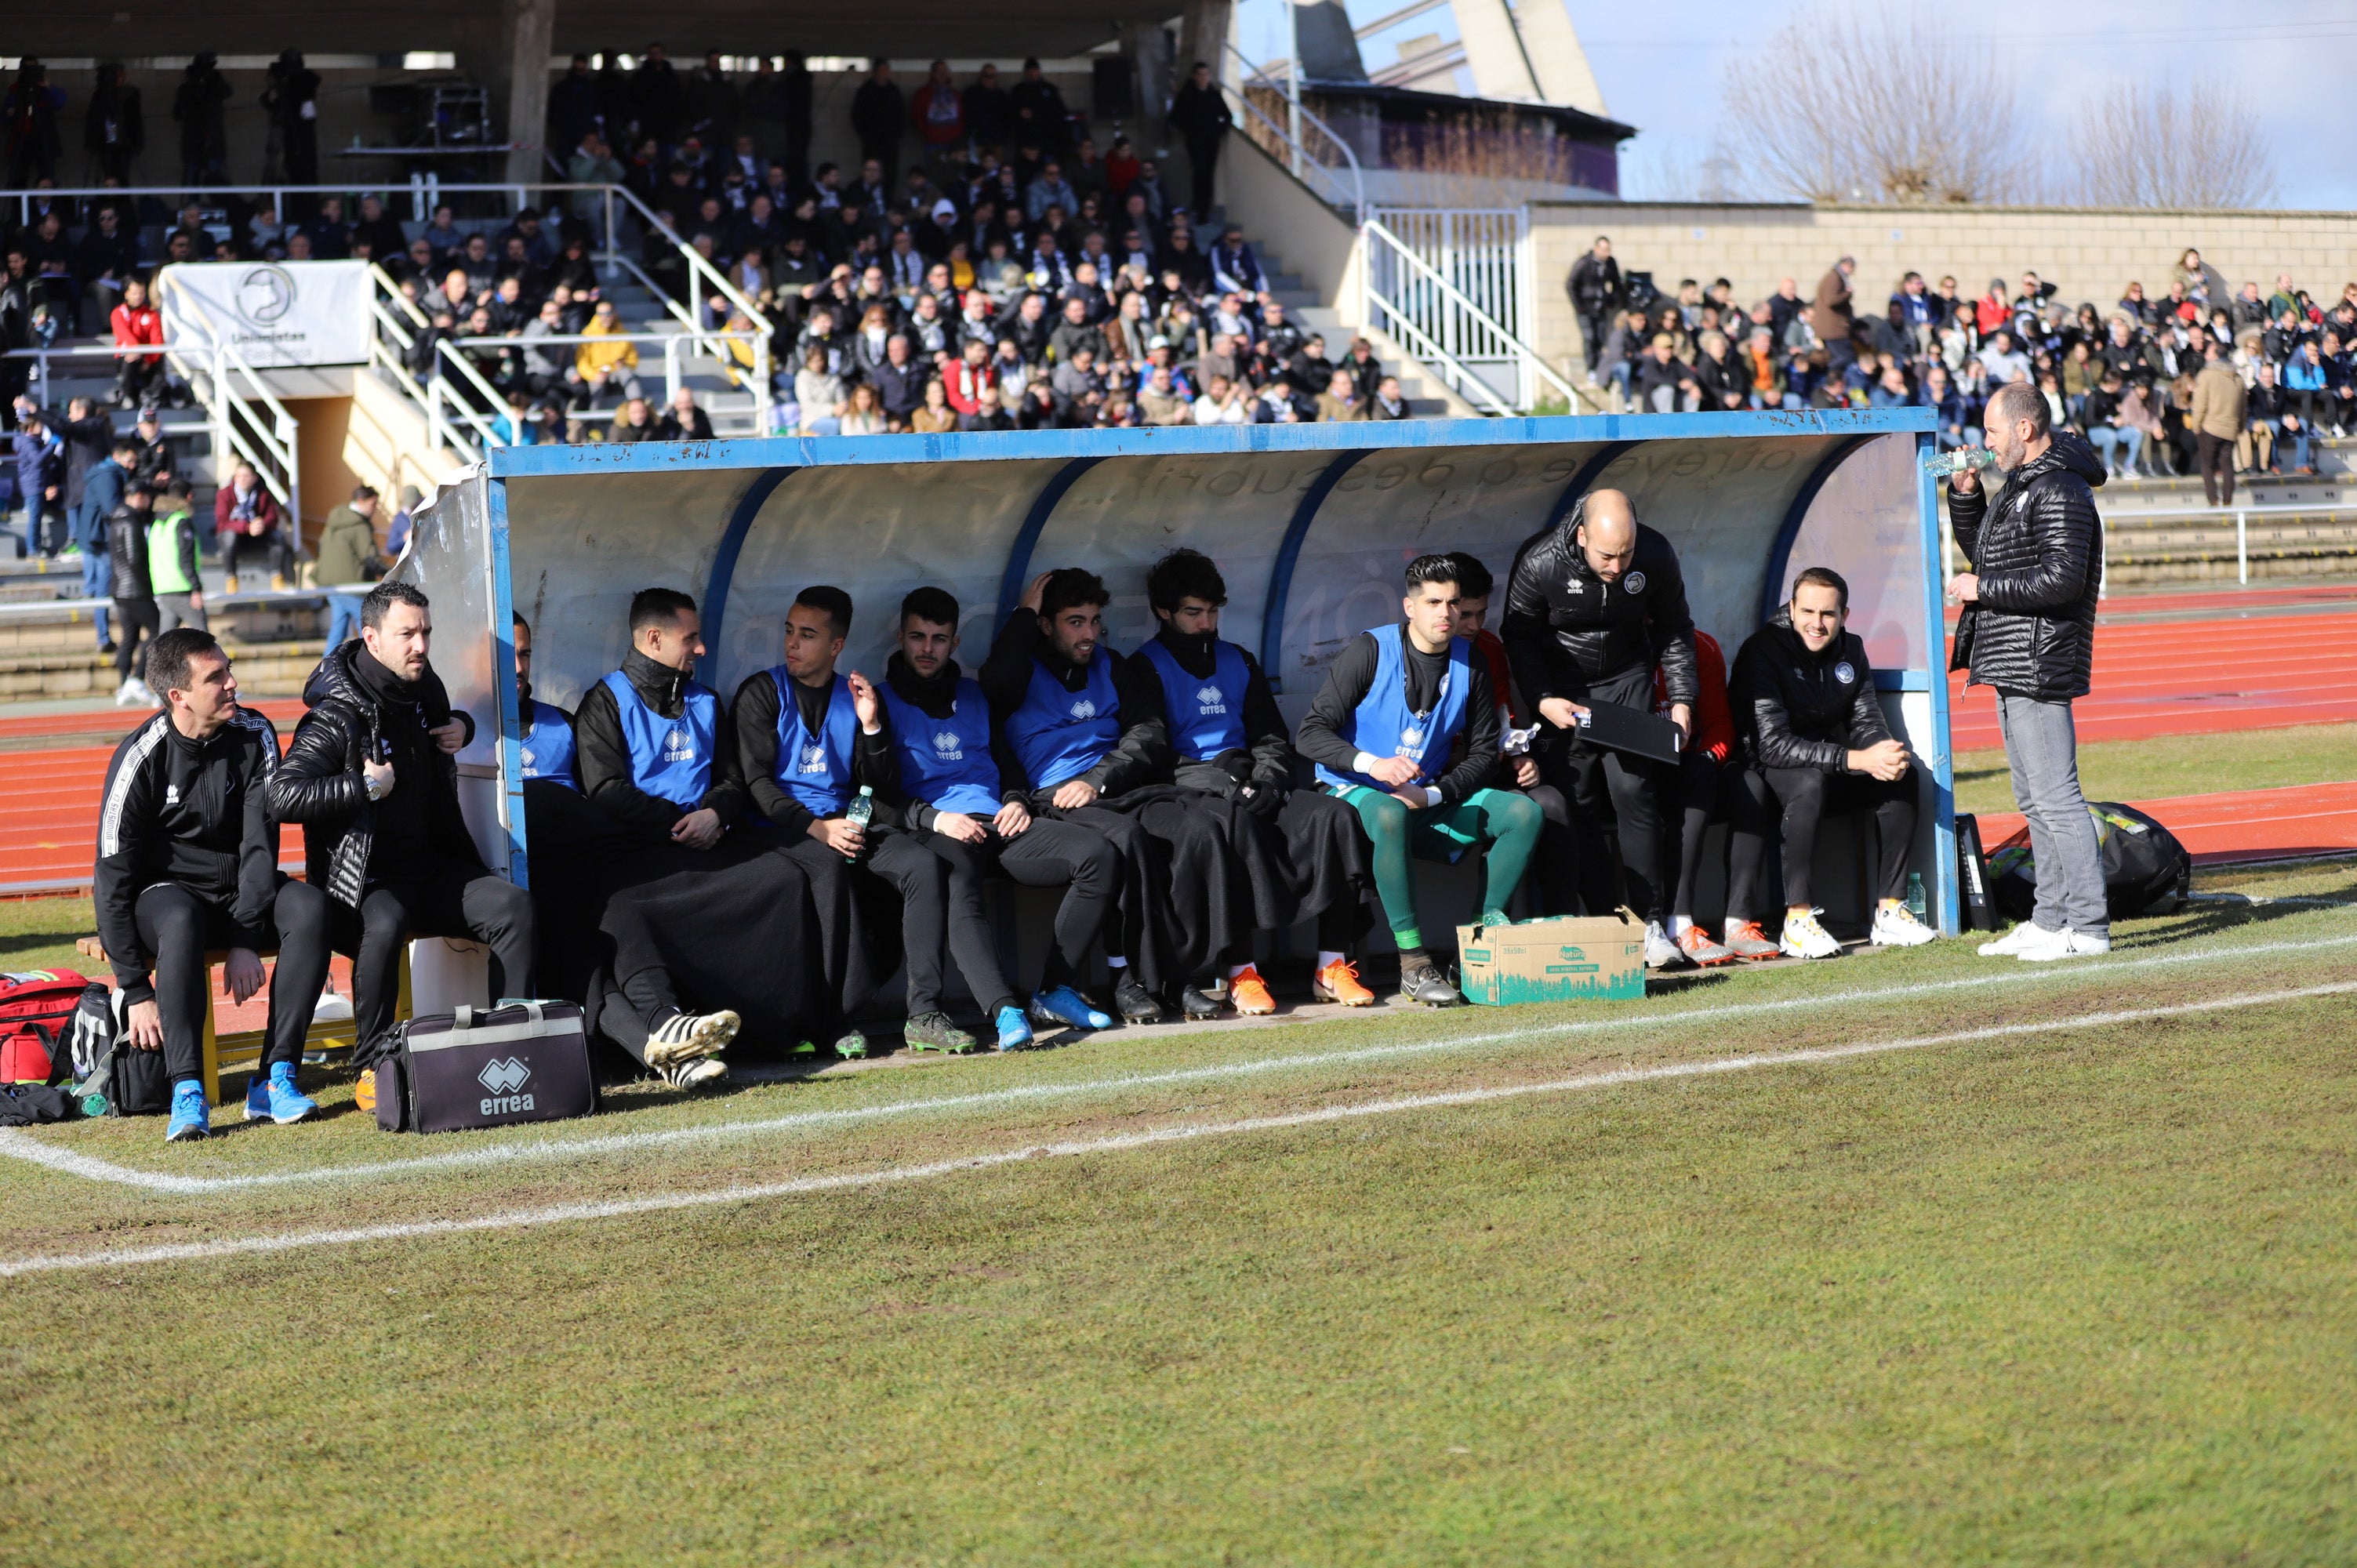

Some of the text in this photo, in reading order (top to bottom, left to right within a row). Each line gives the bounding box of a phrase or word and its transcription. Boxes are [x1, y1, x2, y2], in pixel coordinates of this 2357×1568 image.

[231, 332, 306, 345] Unionistas
[1200, 704, 1226, 715] errea
[664, 749, 694, 762] errea
[936, 750, 963, 760] errea
[1395, 746, 1423, 760] errea
[798, 762, 826, 774] errea
[106, 803, 118, 840] UNIONISTAS
[1560, 950, 1585, 959] Natura
[480, 1094, 535, 1116] errea
